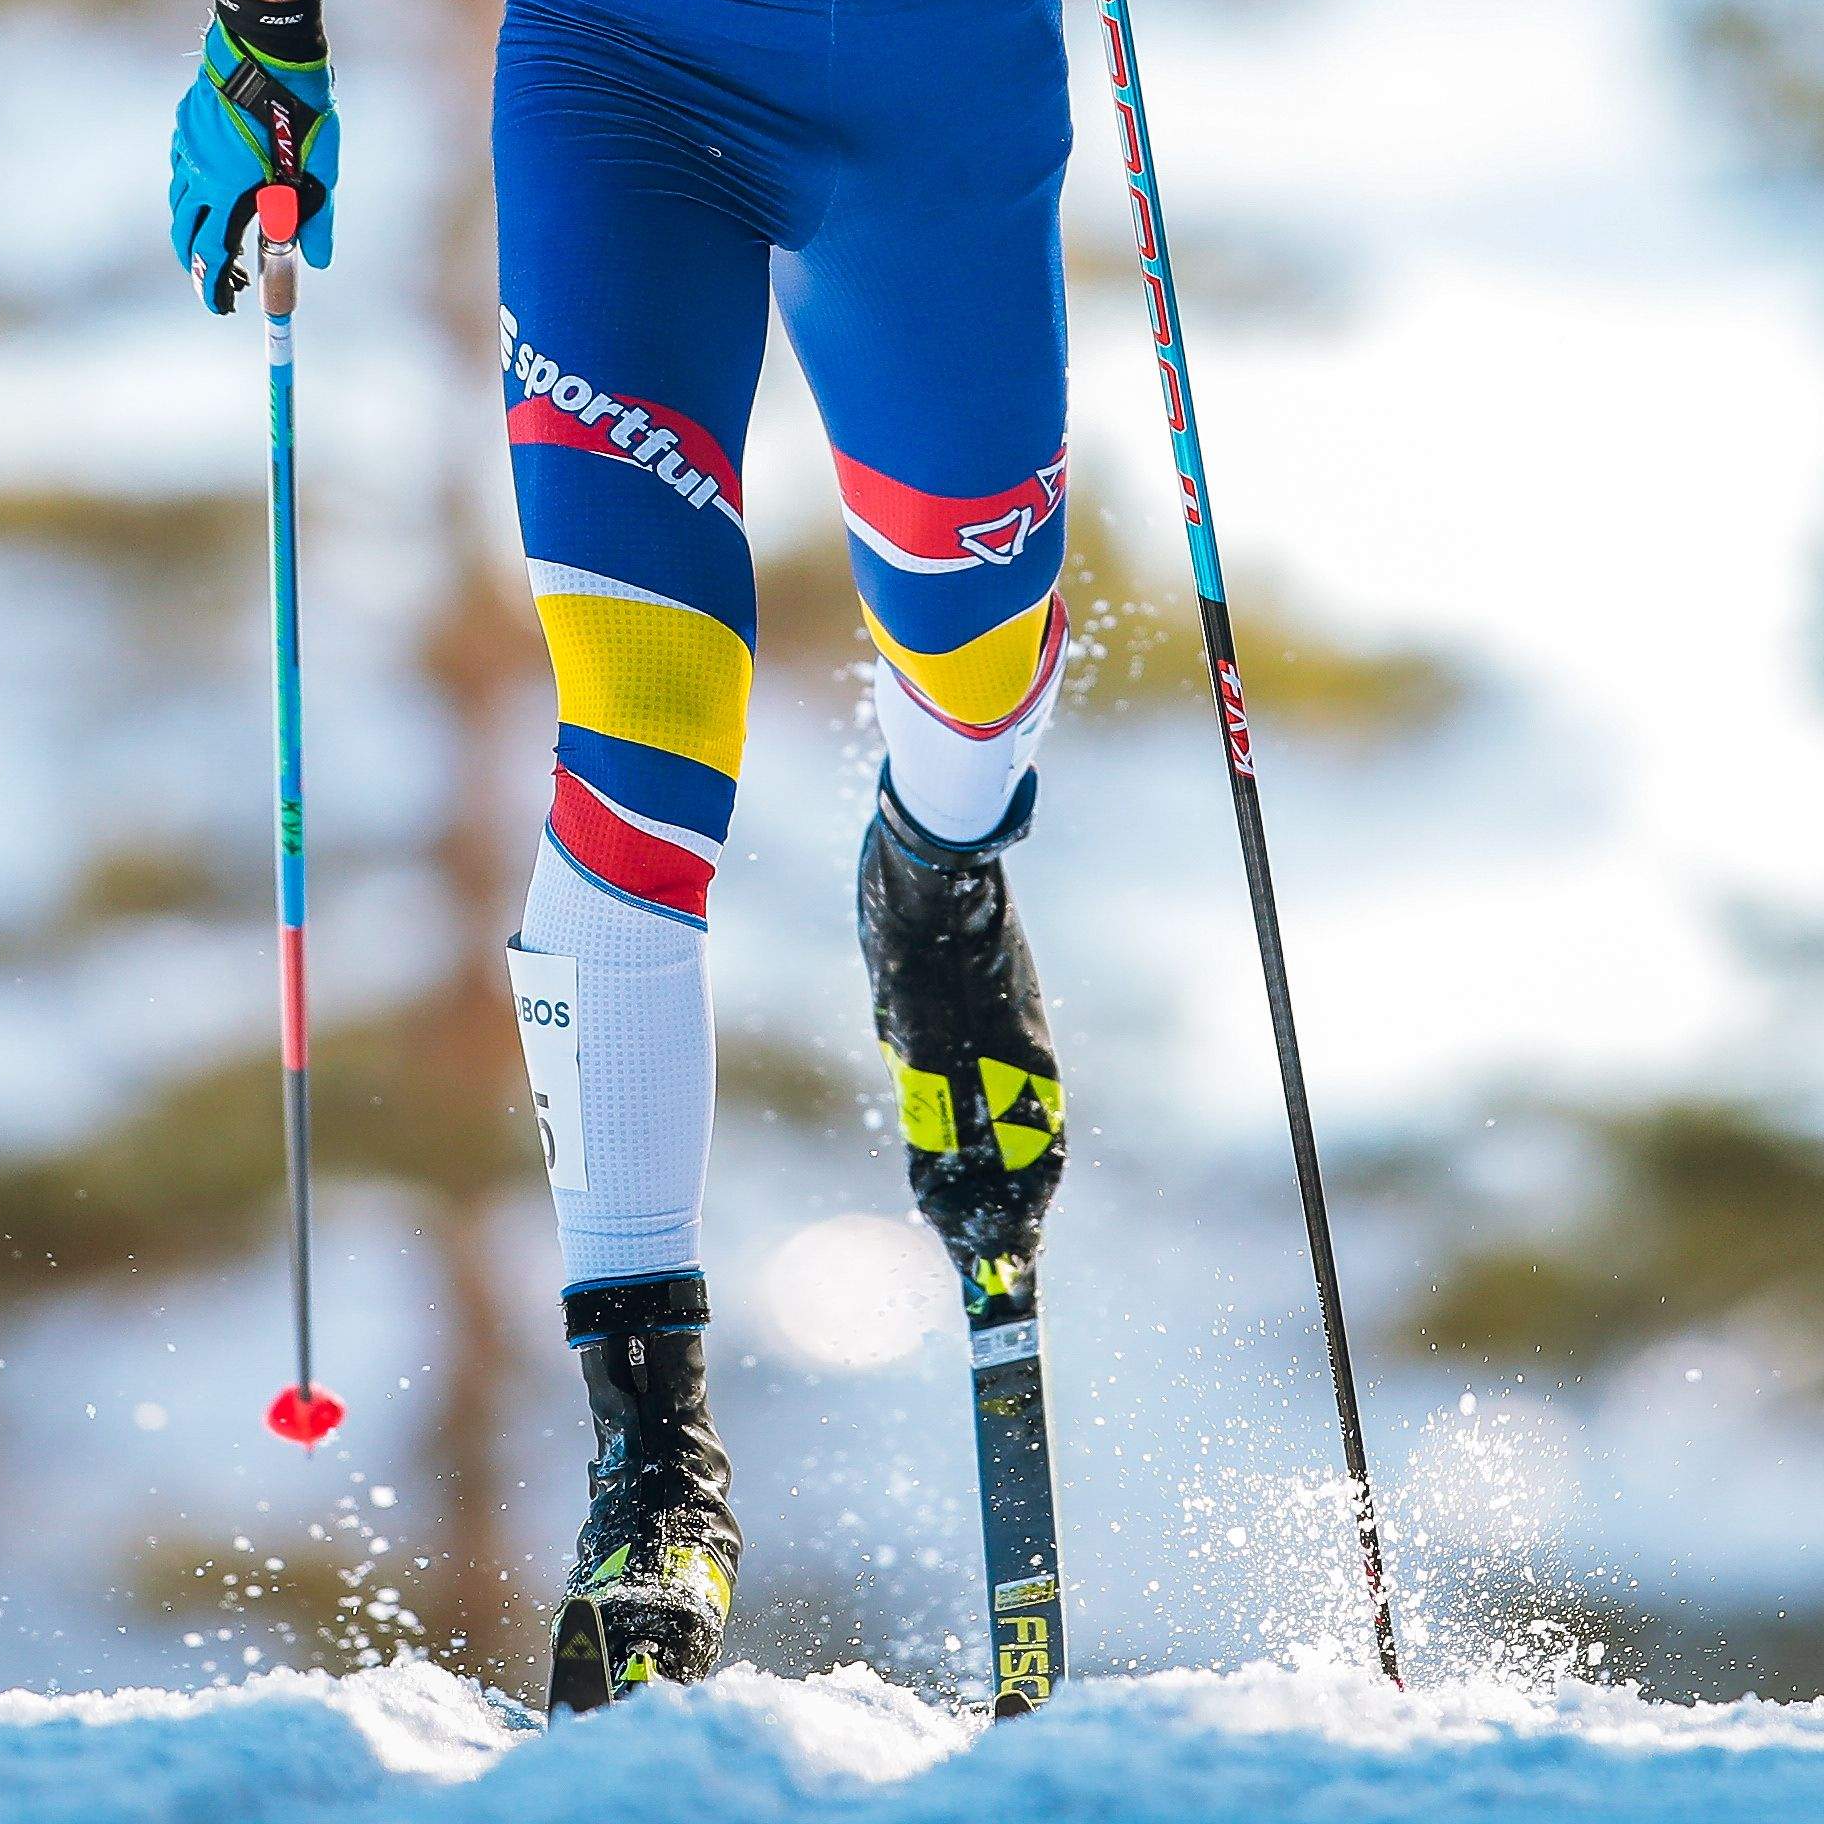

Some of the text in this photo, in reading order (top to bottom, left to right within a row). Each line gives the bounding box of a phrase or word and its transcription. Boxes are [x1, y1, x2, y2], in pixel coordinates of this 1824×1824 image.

[515, 342, 719, 510] sportful
[514, 994, 571, 1028] BOS
[997, 1616, 1049, 1702] FISC
